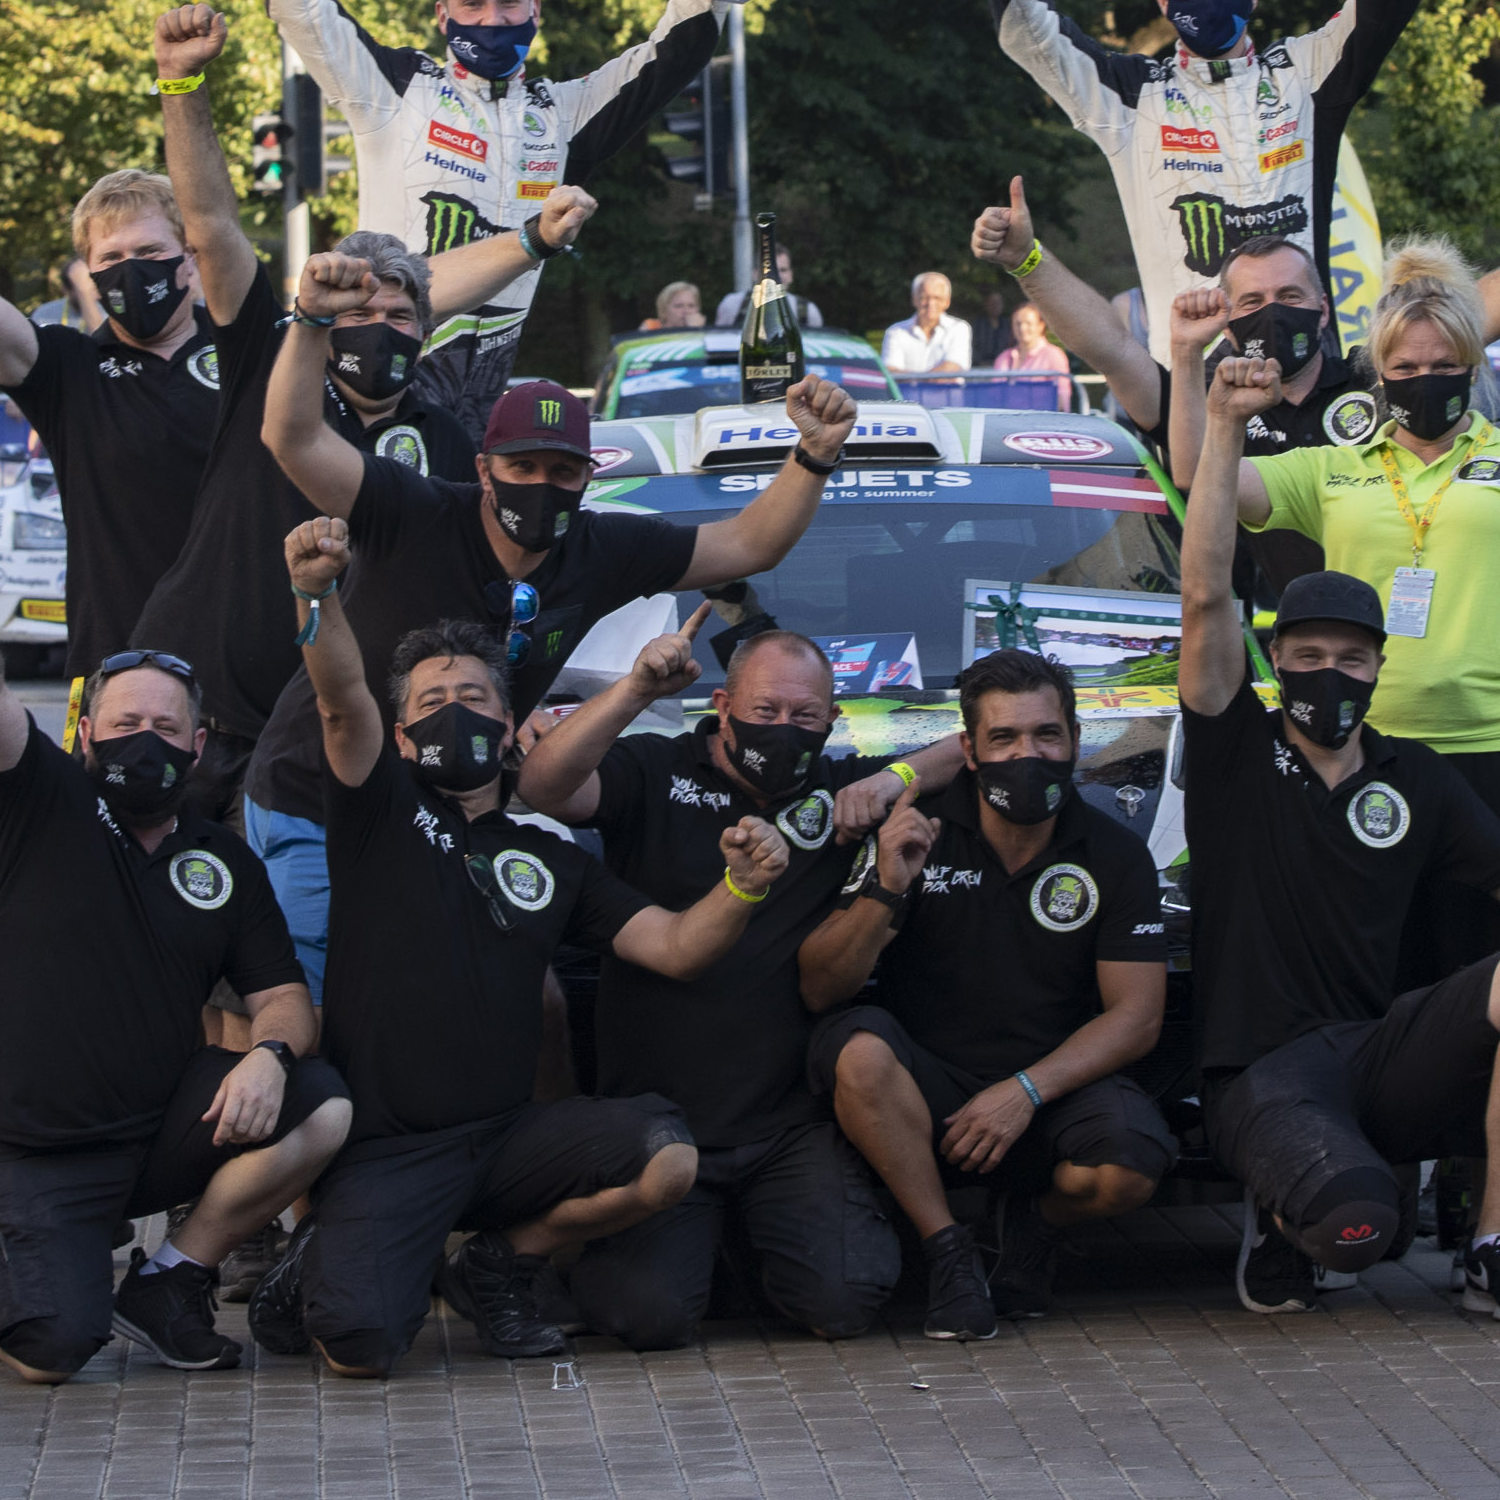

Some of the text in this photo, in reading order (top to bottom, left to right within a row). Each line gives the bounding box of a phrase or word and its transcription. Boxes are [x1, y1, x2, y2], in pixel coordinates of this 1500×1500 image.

[432, 127, 470, 149] CIRCLE
[1163, 131, 1199, 145] CIRCLE
[425, 151, 487, 184] Helmia
[1163, 158, 1224, 174] Helmia
[1263, 142, 1304, 170] PIRELLI
[1224, 202, 1303, 230] MONSTER
[718, 420, 918, 445] Heia
[718, 470, 973, 493] SEJETS
[839, 489, 858, 499] to
[863, 487, 936, 499] summer
